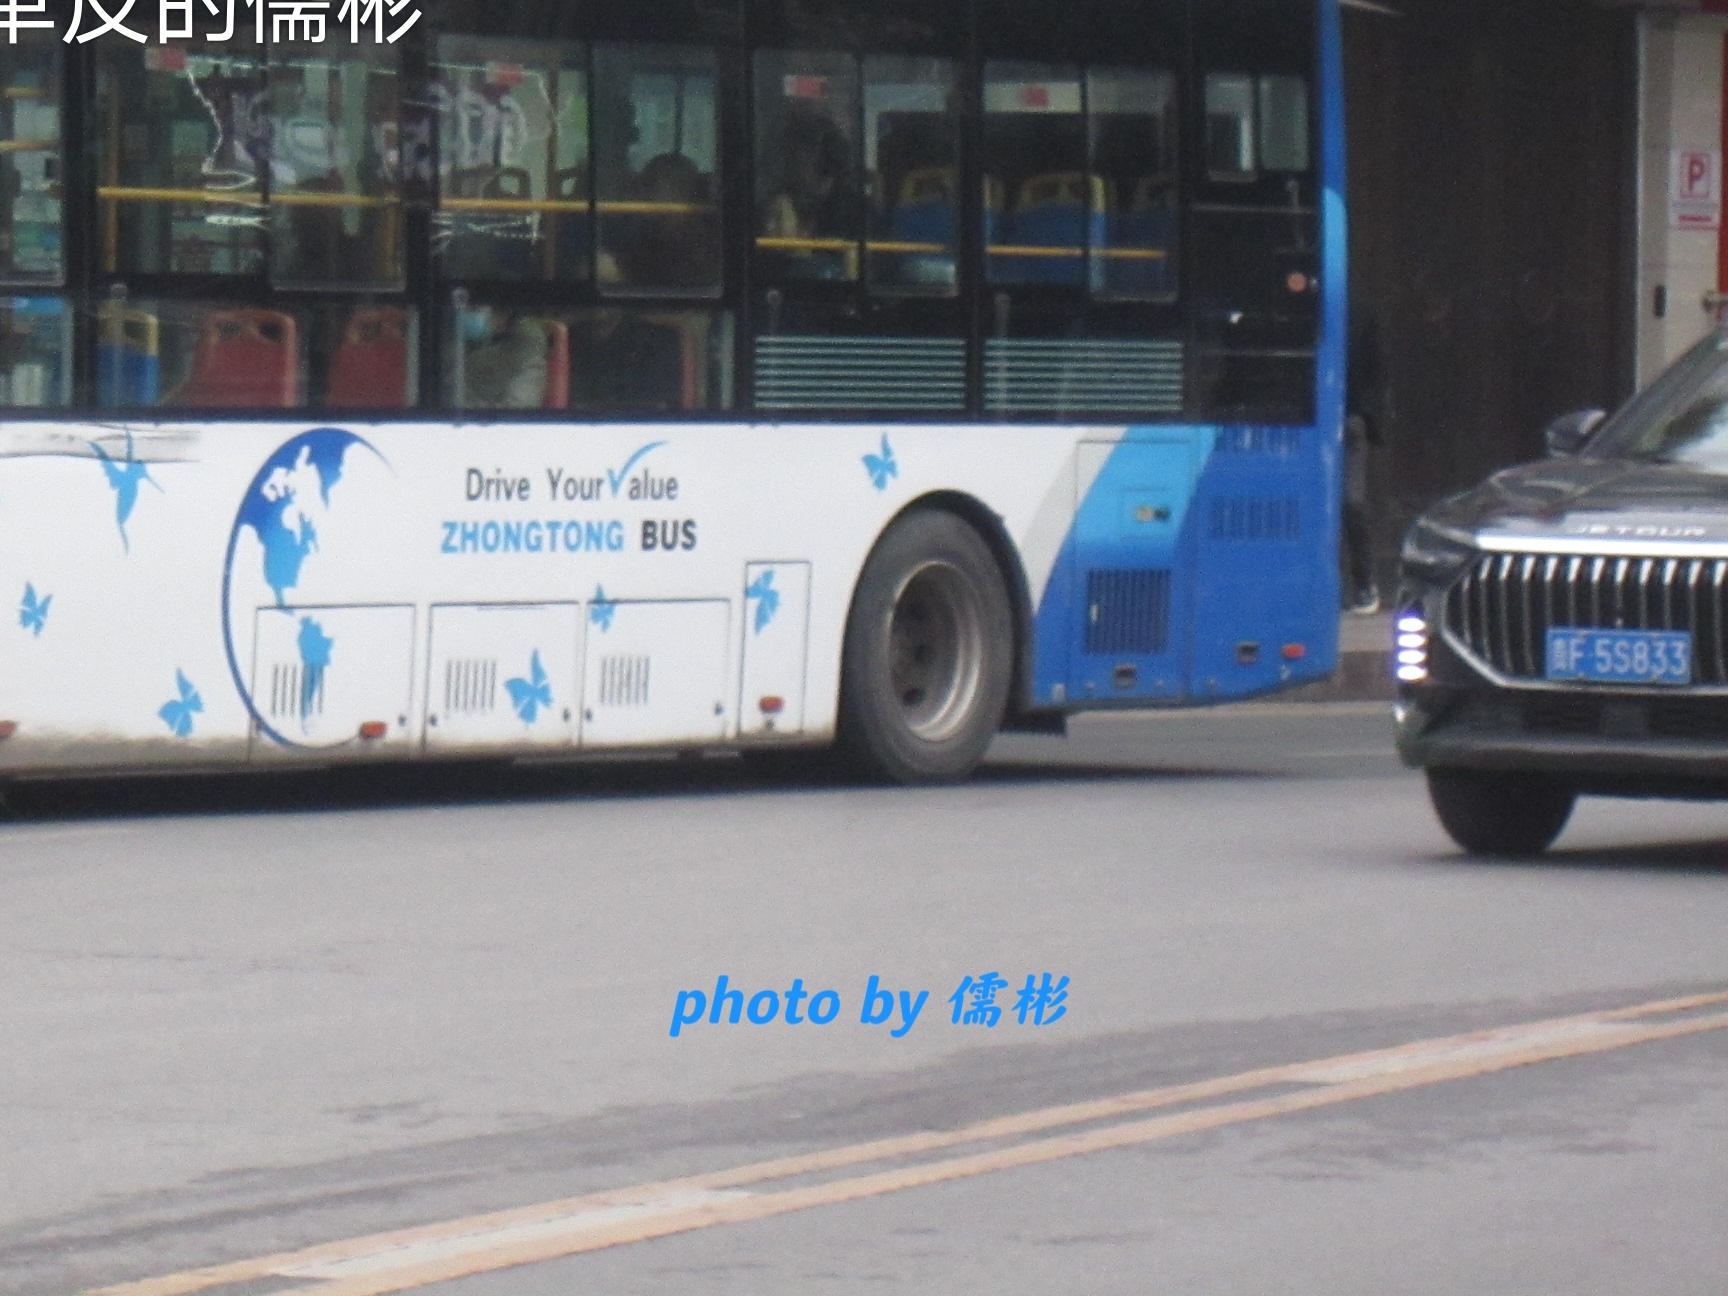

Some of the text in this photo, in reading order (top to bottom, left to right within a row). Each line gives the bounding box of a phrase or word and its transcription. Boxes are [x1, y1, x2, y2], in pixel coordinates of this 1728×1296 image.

[465, 440, 679, 501] Drive Your Value
[441, 518, 697, 553] ZHONGTONG BUS
